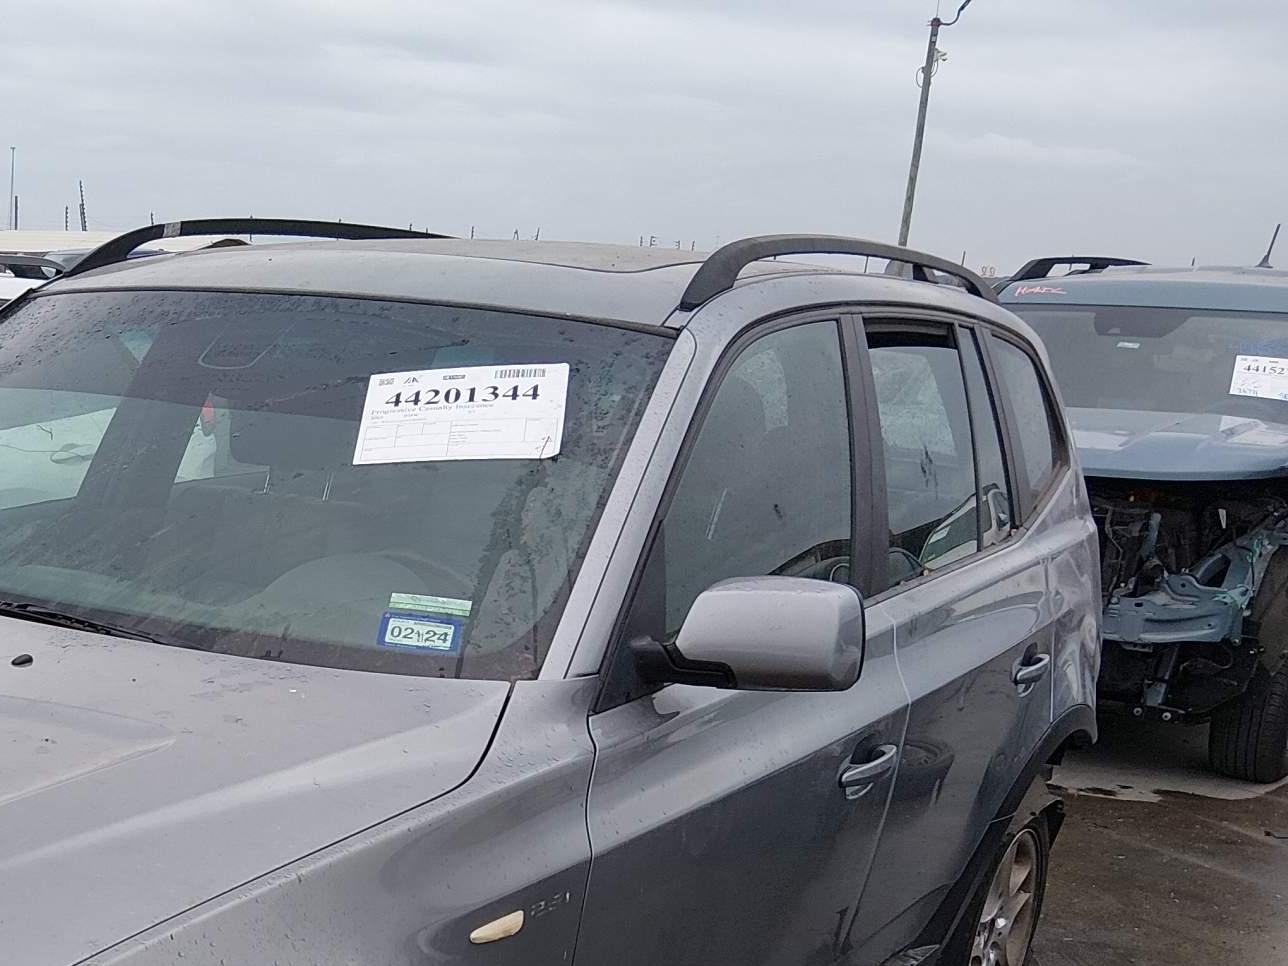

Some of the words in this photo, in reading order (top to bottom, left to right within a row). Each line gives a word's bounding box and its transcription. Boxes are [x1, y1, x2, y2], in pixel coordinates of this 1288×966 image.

[1243, 364, 1288, 376] 44152
[384, 384, 541, 408] 44201344
[390, 625, 415, 640] 02
[423, 630, 449, 644] 24
